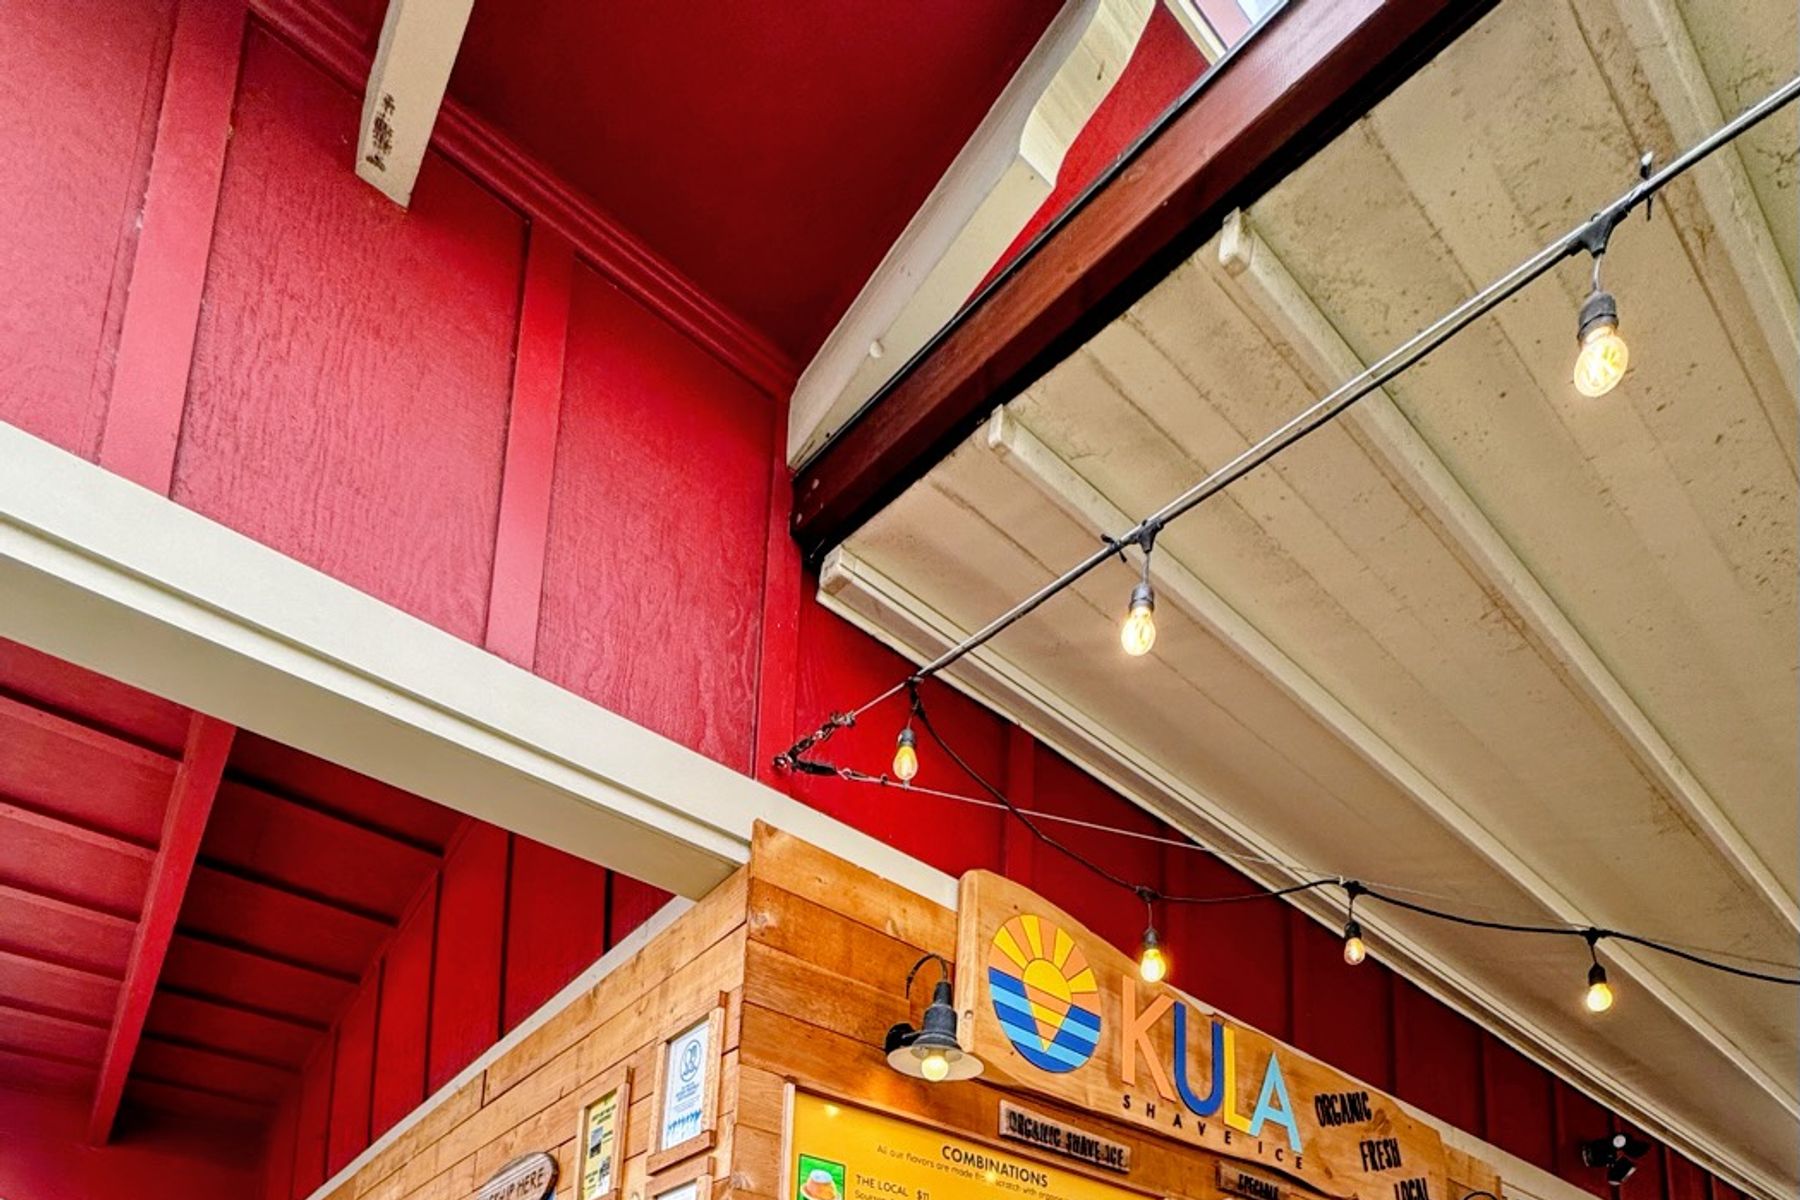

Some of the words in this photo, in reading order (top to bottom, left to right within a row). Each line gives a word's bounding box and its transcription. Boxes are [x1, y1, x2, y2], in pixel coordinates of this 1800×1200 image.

[1121, 975, 1303, 1153] KULA
[1315, 1091, 1372, 1127] ORGANIC
[1008, 1110, 1061, 1147] ORGANIC
[1066, 1131, 1100, 1159] SHAVE
[1104, 1144, 1124, 1167] ICE
[1122, 1093, 1232, 1145] SHAVE
[1257, 1139, 1303, 1170] ICE
[906, 1151, 935, 1168] flavors
[935, 1160, 950, 1172] are
[951, 1164, 974, 1179] made
[941, 1145, 1049, 1188] COMBINATIONS
[1359, 1138, 1402, 1172] FRESH
[516, 1166, 545, 1198] HERE
[856, 1175, 875, 1188] THE
[878, 1179, 909, 1197] LOCAL
